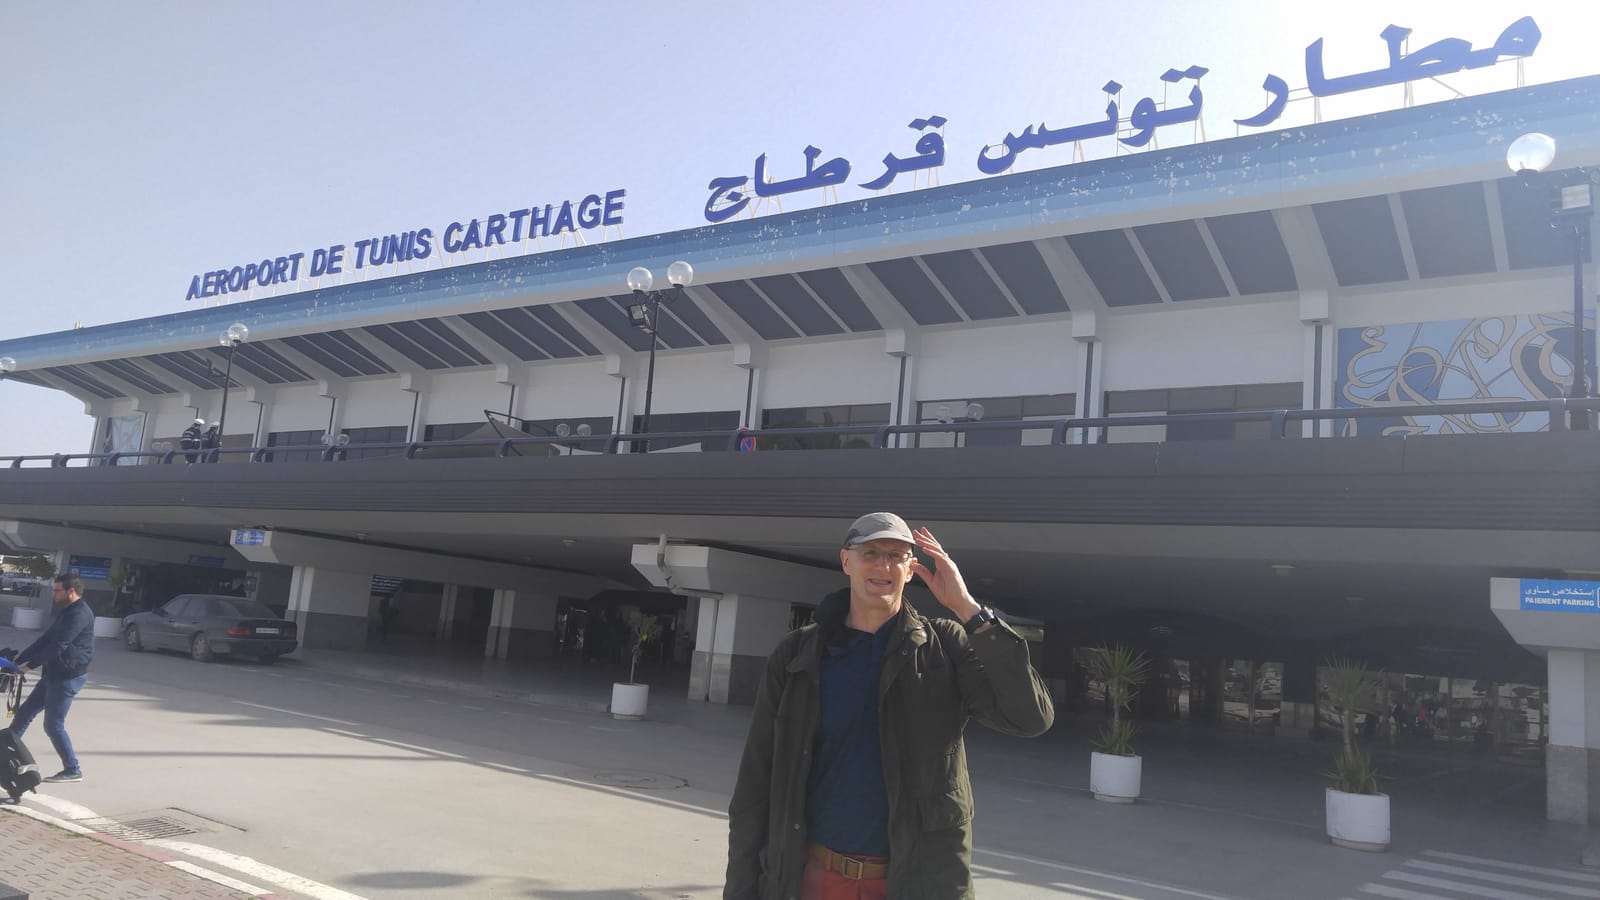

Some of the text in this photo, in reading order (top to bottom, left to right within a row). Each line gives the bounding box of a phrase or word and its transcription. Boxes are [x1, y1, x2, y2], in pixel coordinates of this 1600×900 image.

[704, 16, 1542, 223] مطار تونس قرطاج
[185, 188, 626, 300] AEROPORT DE TUNIS CARTHAGE
[1525, 597, 1595, 607] PAIEMENT PARKING
